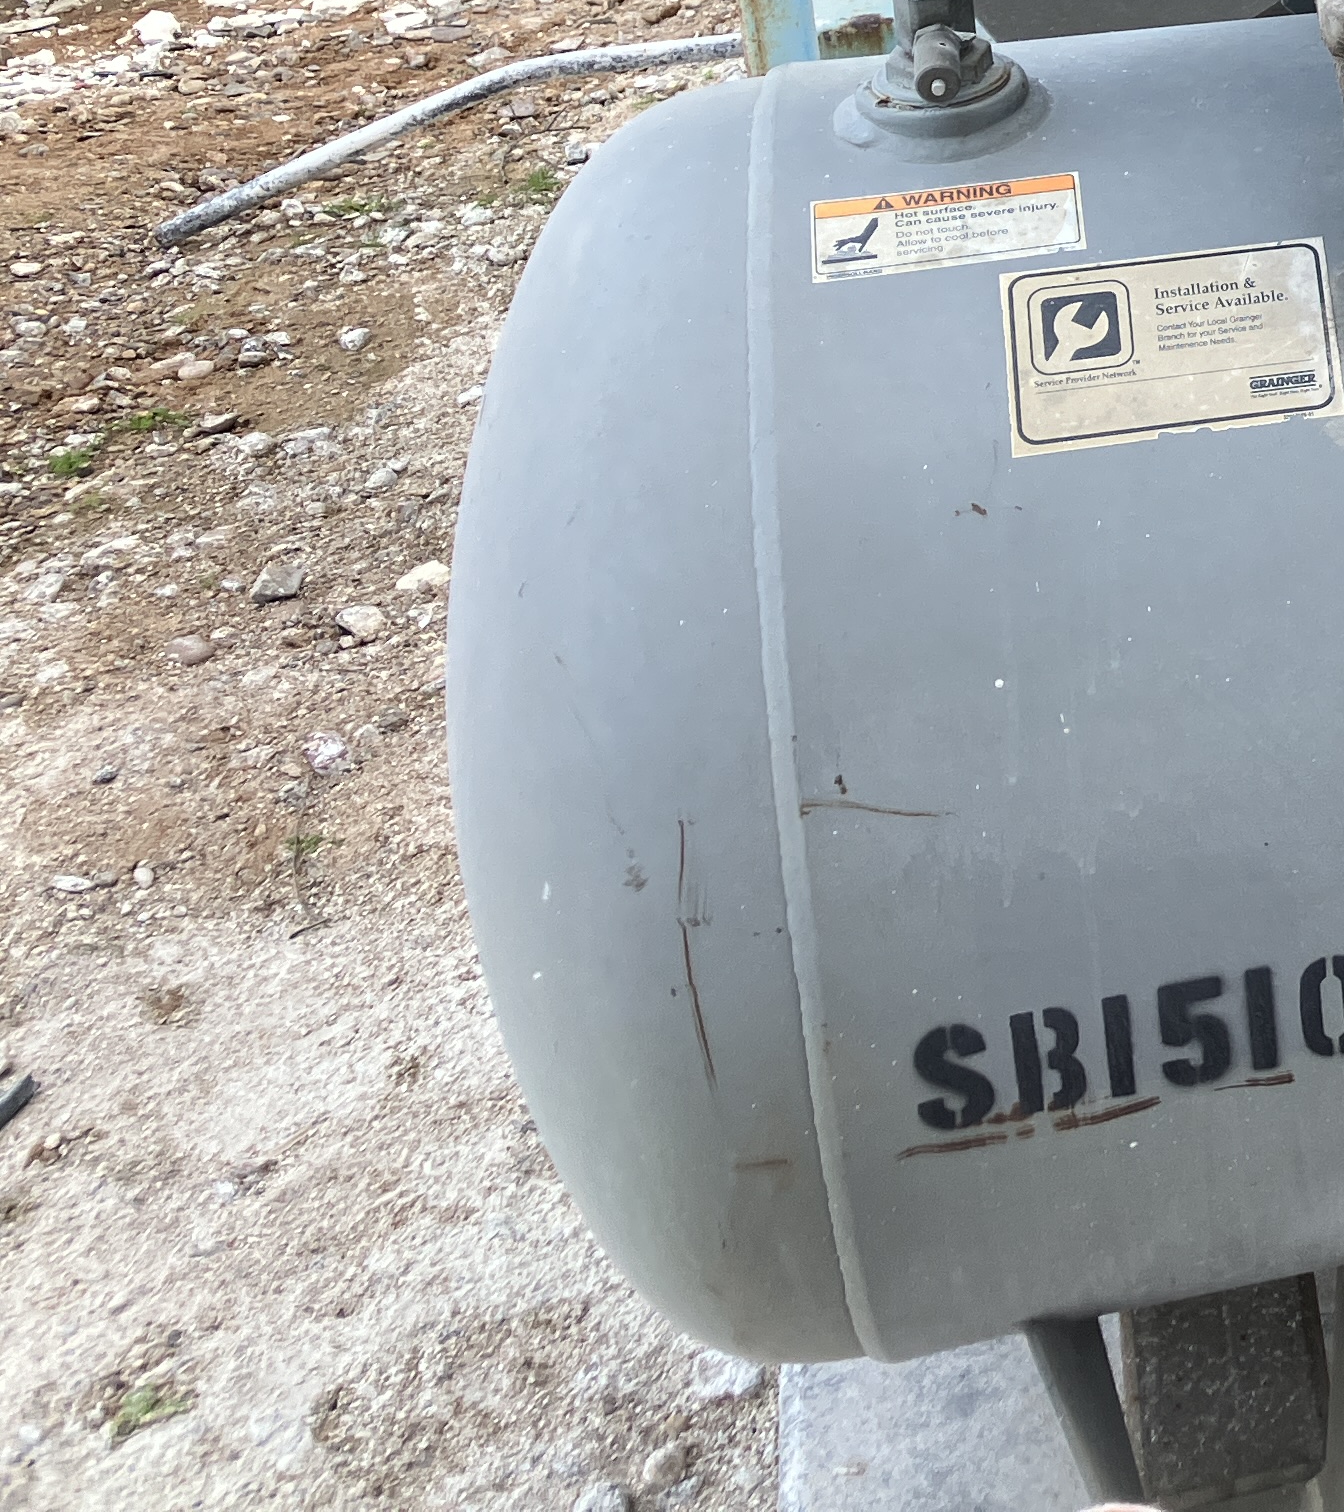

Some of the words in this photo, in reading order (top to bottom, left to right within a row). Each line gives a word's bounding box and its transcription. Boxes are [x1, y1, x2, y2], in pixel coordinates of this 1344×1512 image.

[902, 183, 1012, 207] WARNING
[894, 210, 919, 220] Hot
[922, 205, 977, 216] surface.
[895, 219, 921, 228] Can
[925, 213, 968, 225] cause
[970, 208, 1015, 219] severe
[1018, 202, 1060, 214] injury.
[896, 230, 913, 239] Do
[915, 228, 934, 237] not
[896, 239, 927, 248] Allow
[930, 236, 942, 245] to
[944, 233, 969, 243] cool
[971, 227, 1010, 239] before
[1154, 280, 1240, 300] Installation
[1243, 277, 1257, 289] &
[1155, 299, 1210, 316] Service
[1214, 289, 1289, 309] Available.
[1157, 323, 1187, 332] Contact
[1188, 320, 1206, 328] Your
[1207, 317, 1228, 326] Local
[1229, 313, 1263, 324] Grainger
[1158, 332, 1186, 342] Branch
[1187, 330, 1198, 338] for
[1199, 329, 1217, 339] your
[1217, 326, 1247, 335] Service
[1248, 322, 1264, 331] and
[1033, 376, 1064, 388] Service
[1065, 373, 1101, 387] Provider
[1101, 368, 1138, 381] Network
[1249, 372, 1318, 390] GRAINGER
